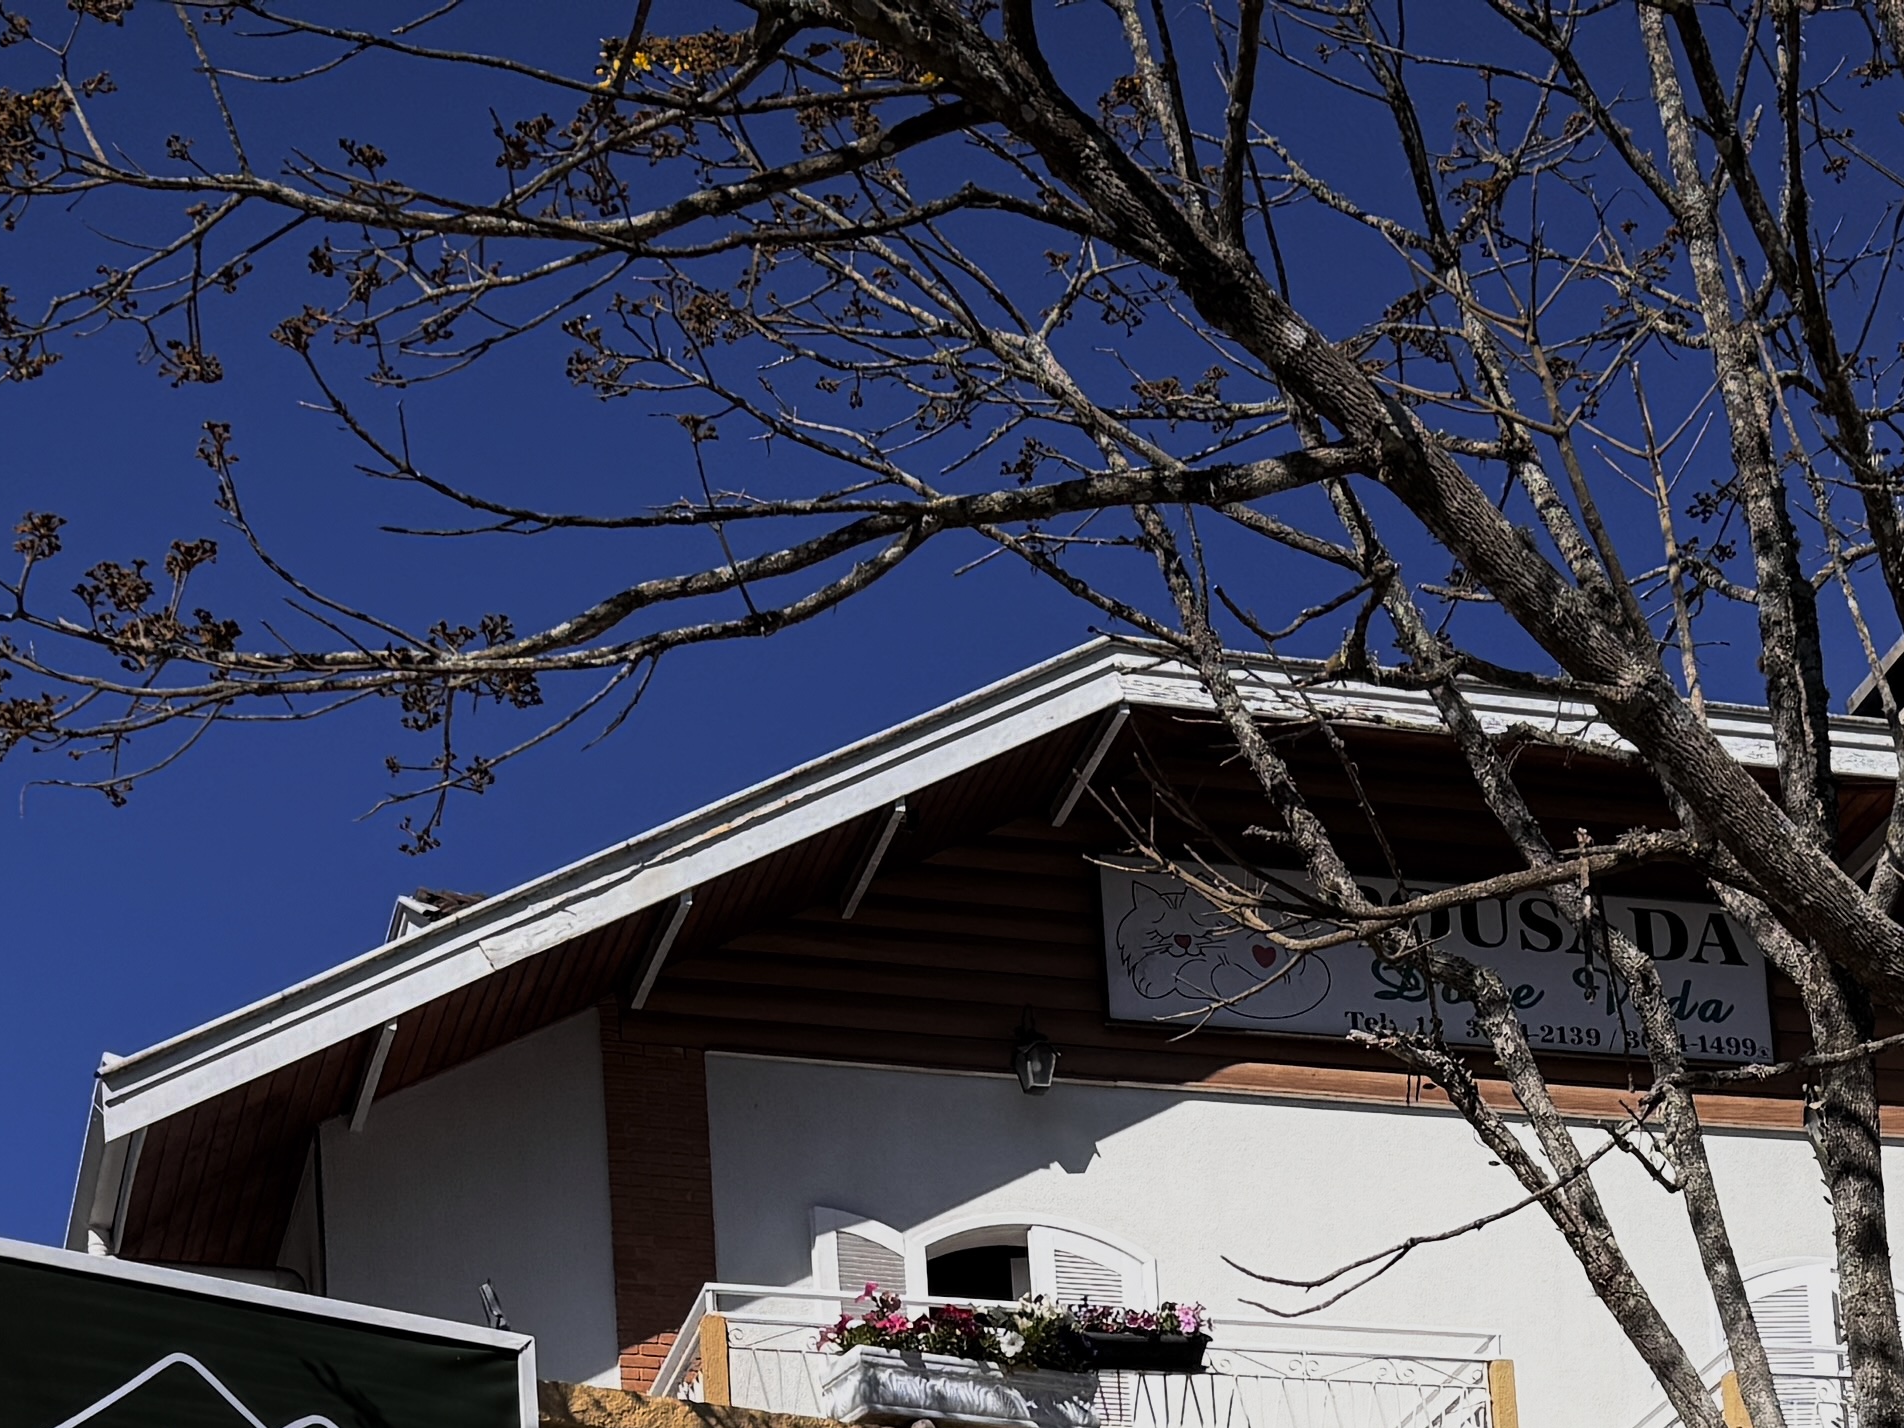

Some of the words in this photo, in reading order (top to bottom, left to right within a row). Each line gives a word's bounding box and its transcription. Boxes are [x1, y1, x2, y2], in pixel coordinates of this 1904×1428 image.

[1357, 884, 1749, 967] OUSDA
[1371, 957, 1545, 1010] Doe
[1572, 966, 1735, 1023] Vda
[1466, 1020, 1601, 1047] 34-2139
[1625, 1030, 1756, 1057] 34-1499
